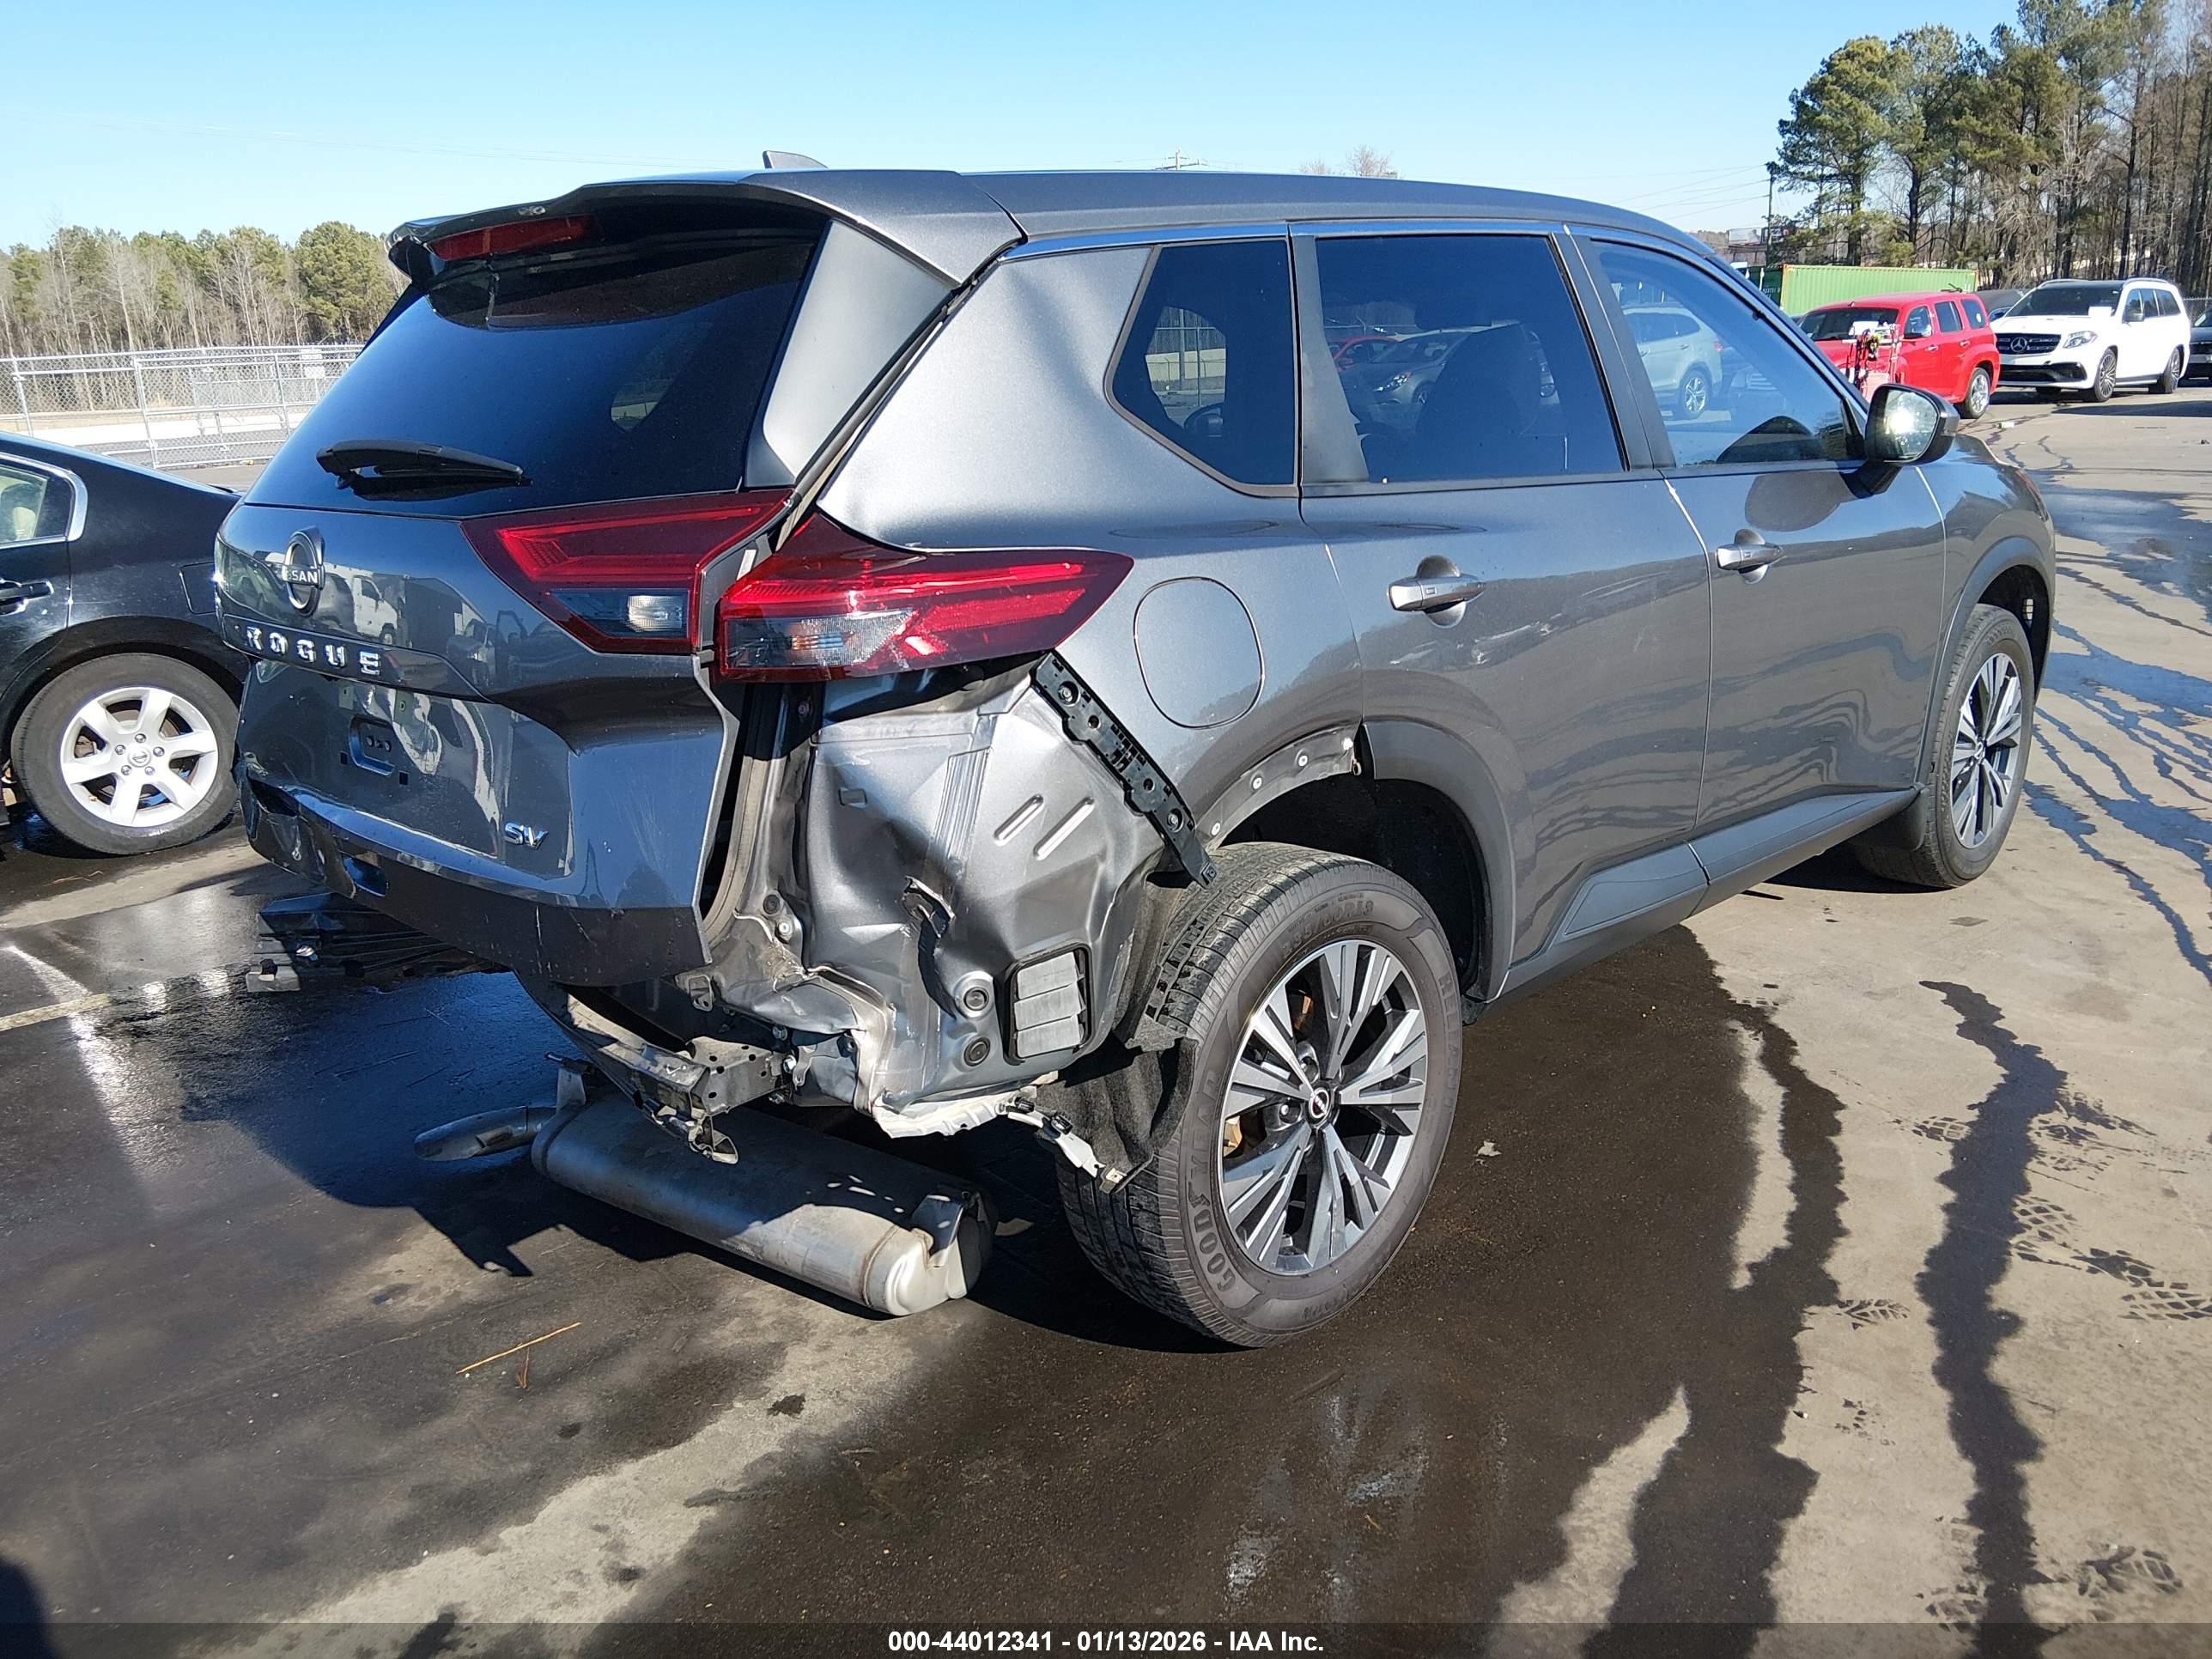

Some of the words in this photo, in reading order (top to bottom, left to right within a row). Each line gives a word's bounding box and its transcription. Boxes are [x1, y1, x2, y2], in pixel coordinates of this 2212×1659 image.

[246, 626, 381, 676] ROGUE
[504, 822, 550, 850] SV
[1188, 1069, 1237, 1292] GOODYEAR
